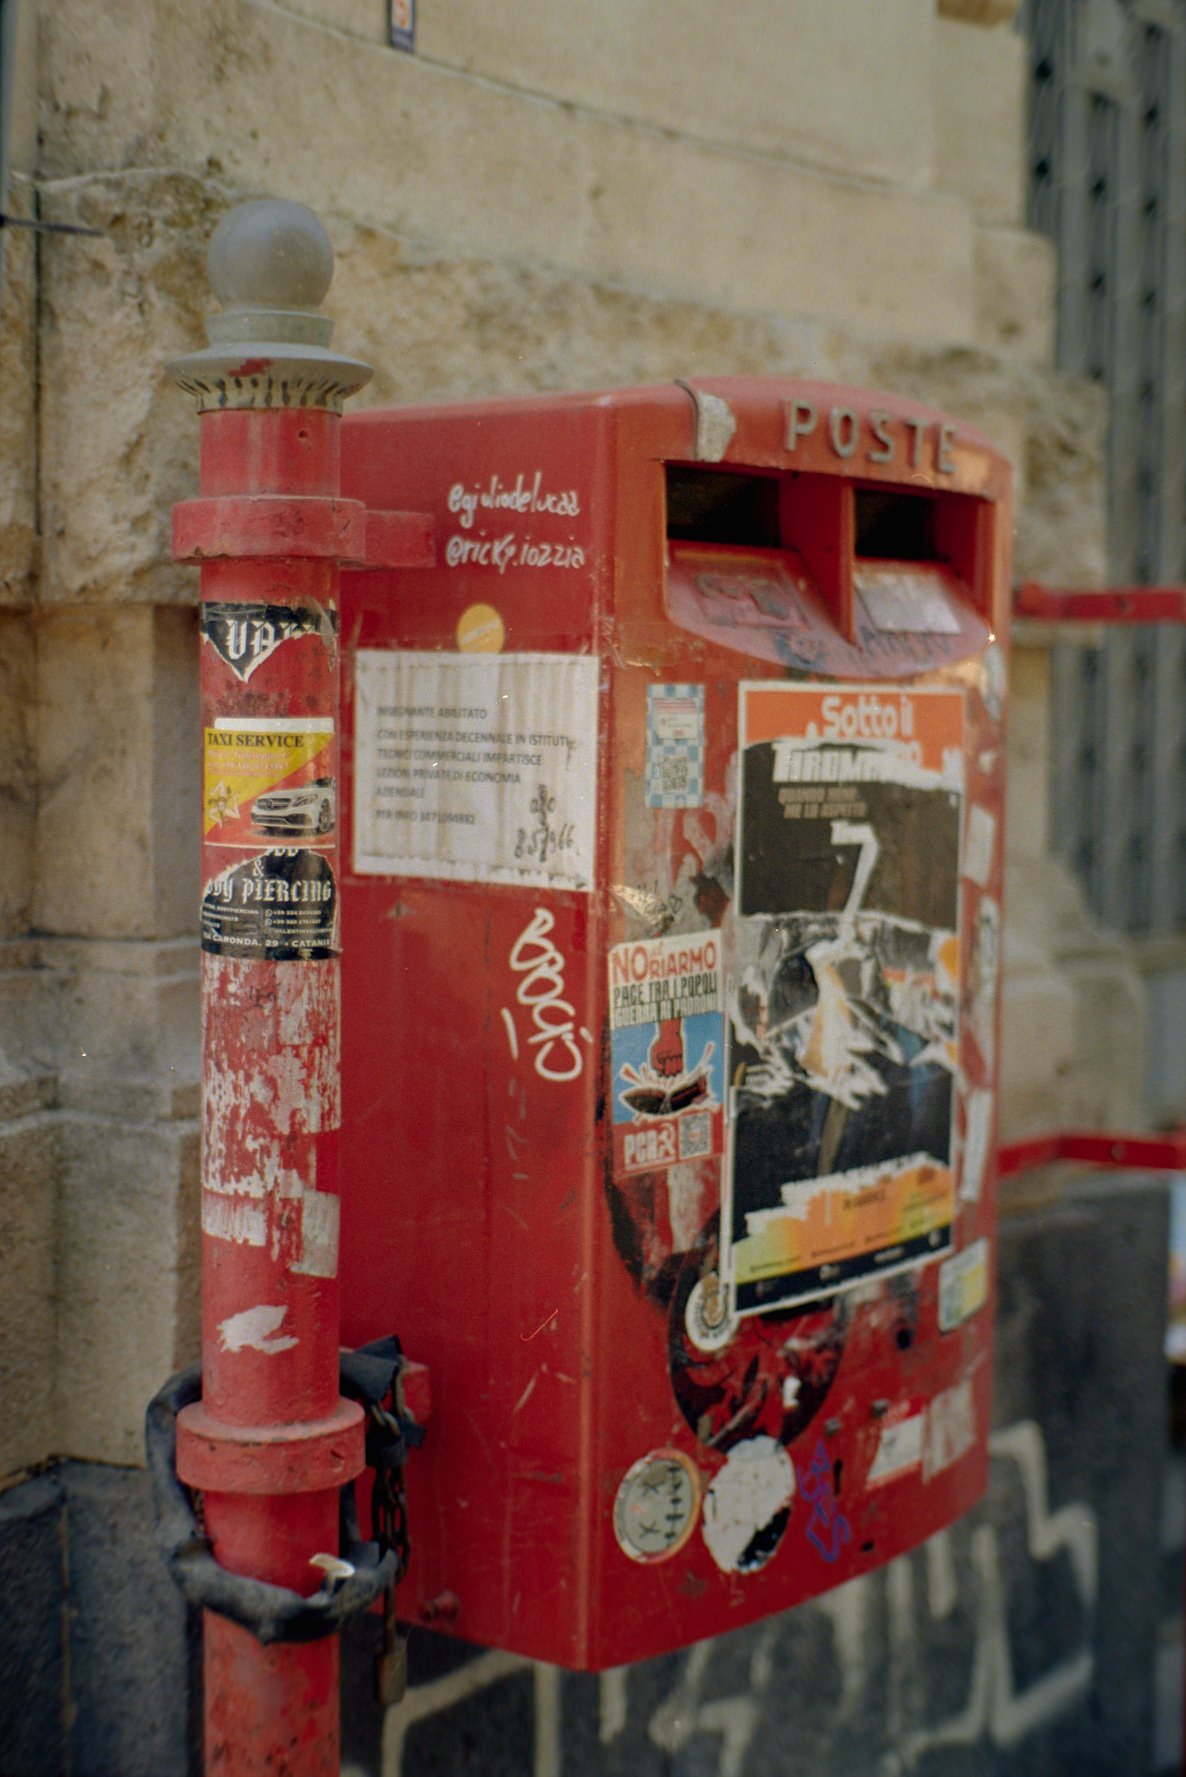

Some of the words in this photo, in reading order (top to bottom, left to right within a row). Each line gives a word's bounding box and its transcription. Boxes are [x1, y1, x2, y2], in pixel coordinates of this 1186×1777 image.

[784, 400, 957, 475] POSTE
[207, 733, 232, 746] TAXI
[236, 735, 305, 748] SERVICE
[455, 731, 513, 745] DECENNALE
[516, 733, 526, 745] IN
[483, 752, 542, 767] IMPARTISCE
[465, 770, 521, 784] ECONOMIA
[253, 857, 265, 877] &
[242, 878, 332, 904] PIERCING
[266, 939, 279, 947] 29
[292, 938, 332, 948] CATANIA
[612, 944, 648, 984] NO
[650, 939, 717, 979] RIARMO
[613, 983, 644, 1009] PACE
[648, 979, 669, 1003] TRA
[680, 972, 717, 999] POPOLI
